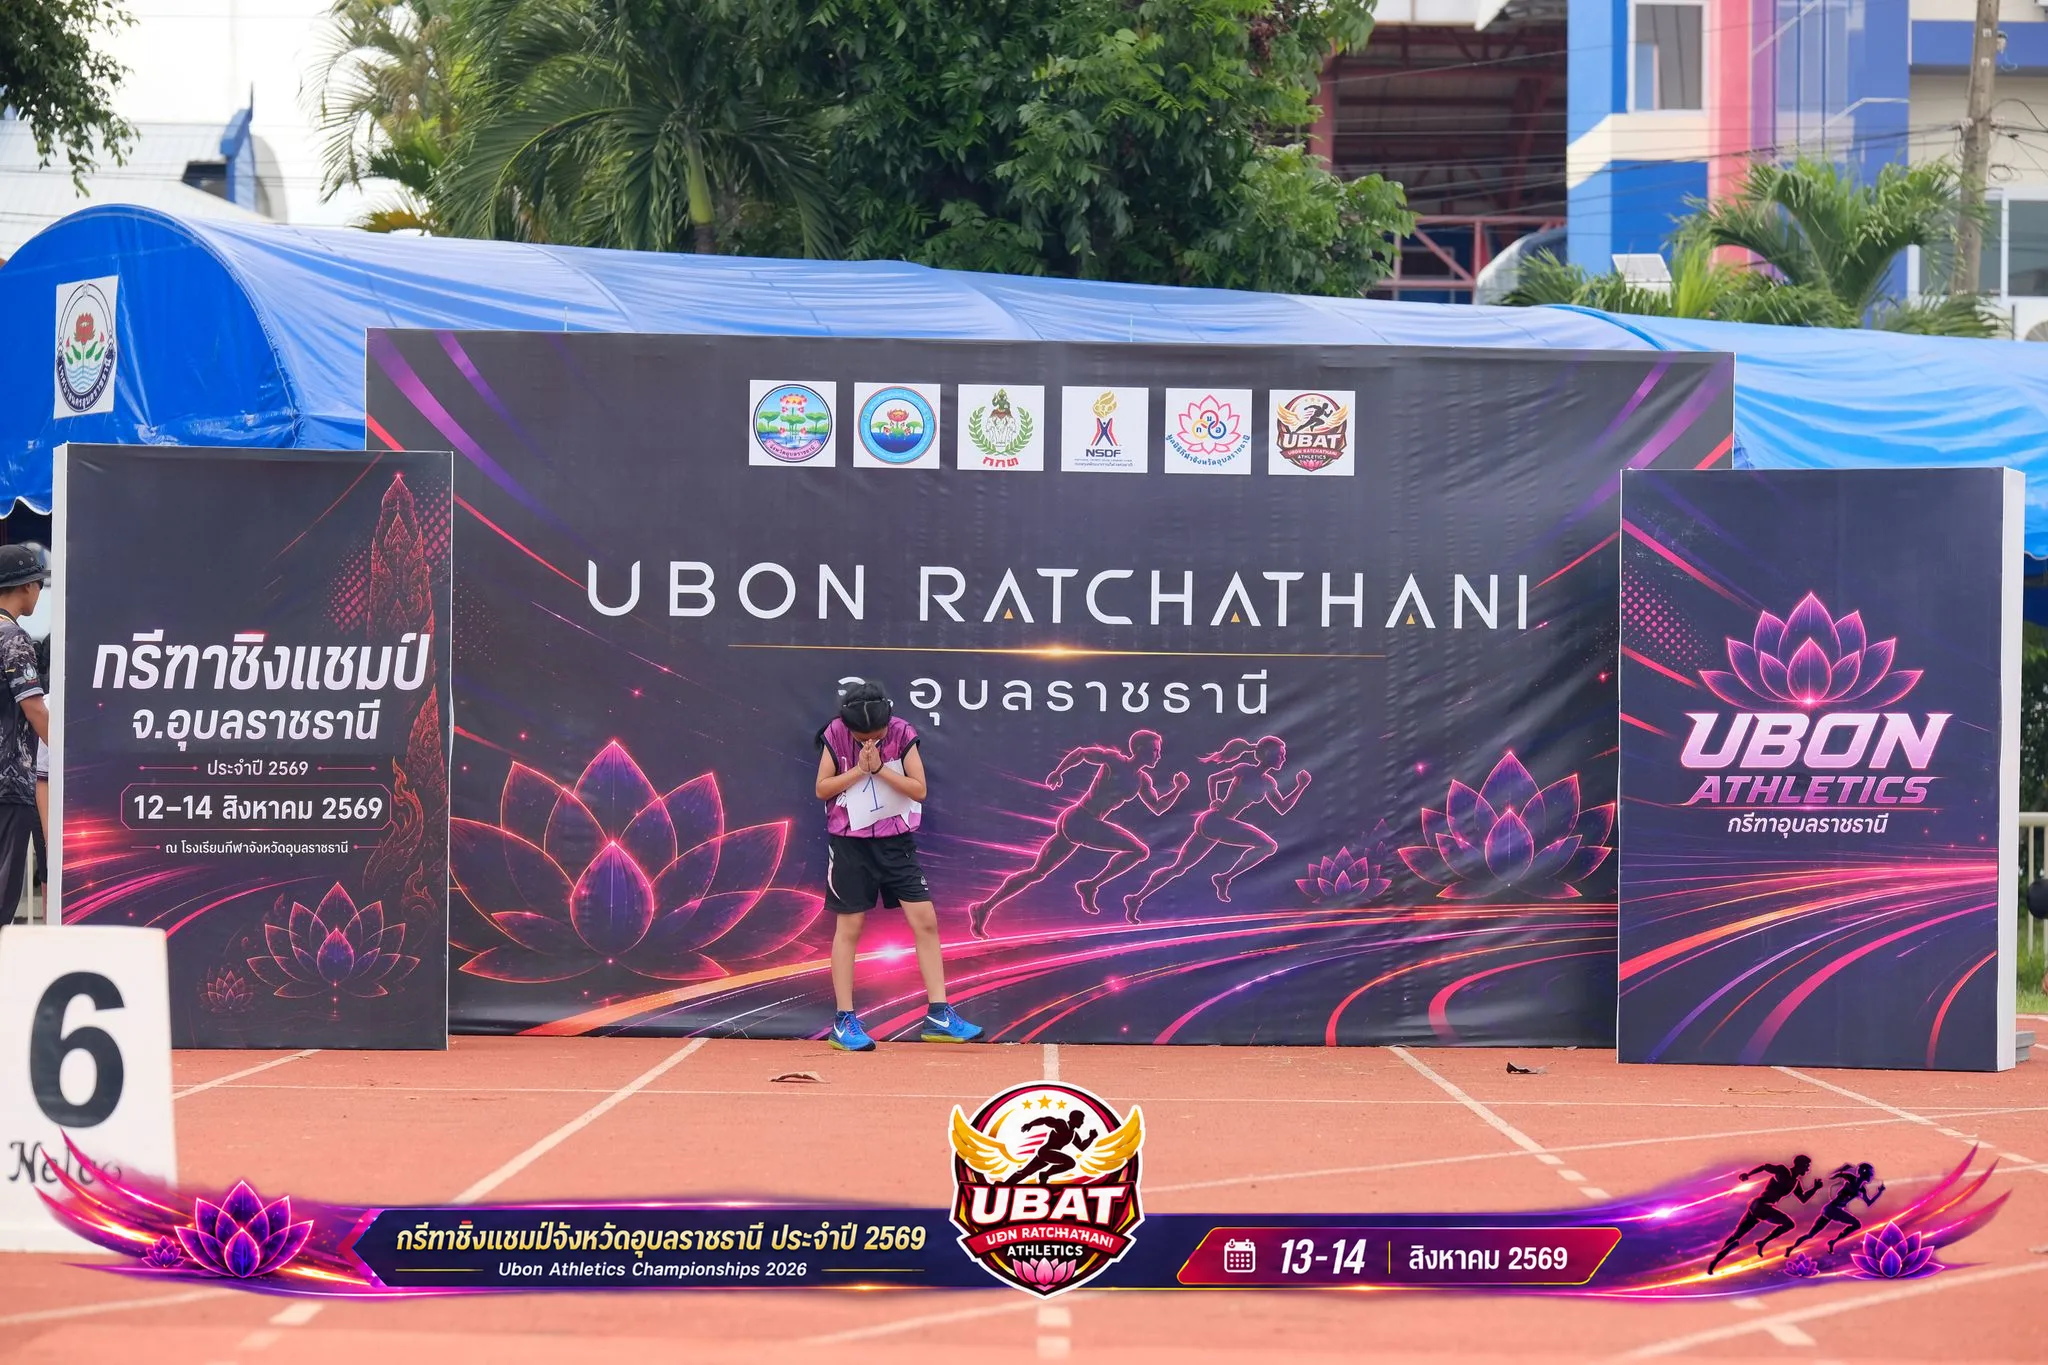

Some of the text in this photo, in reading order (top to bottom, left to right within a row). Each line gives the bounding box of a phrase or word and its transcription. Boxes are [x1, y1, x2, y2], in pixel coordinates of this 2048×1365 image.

[1086, 449, 1121, 457] NSDF
[1282, 433, 1342, 449] UBAT
[587, 559, 1528, 630] UBON RATCHATHANI
[93, 629, 430, 690] กรีฑาชิงแชมป์
[909, 669, 1267, 725] อุบลราชธานี
[132, 699, 381, 751] จ.อุบลราชธานี
[1680, 713, 1953, 769] UBON
[207, 758, 309, 776] ประจำปี 2569
[222, 795, 313, 820] สิงหาคม
[322, 797, 383, 820] 2569
[862, 774, 884, 812] 1
[1683, 776, 1940, 805] ATHLETICS
[165, 840, 348, 857] ณ โรงเรียนกีฬาจังหวัดอุบลราชธานี
[30, 971, 125, 1128] 6
